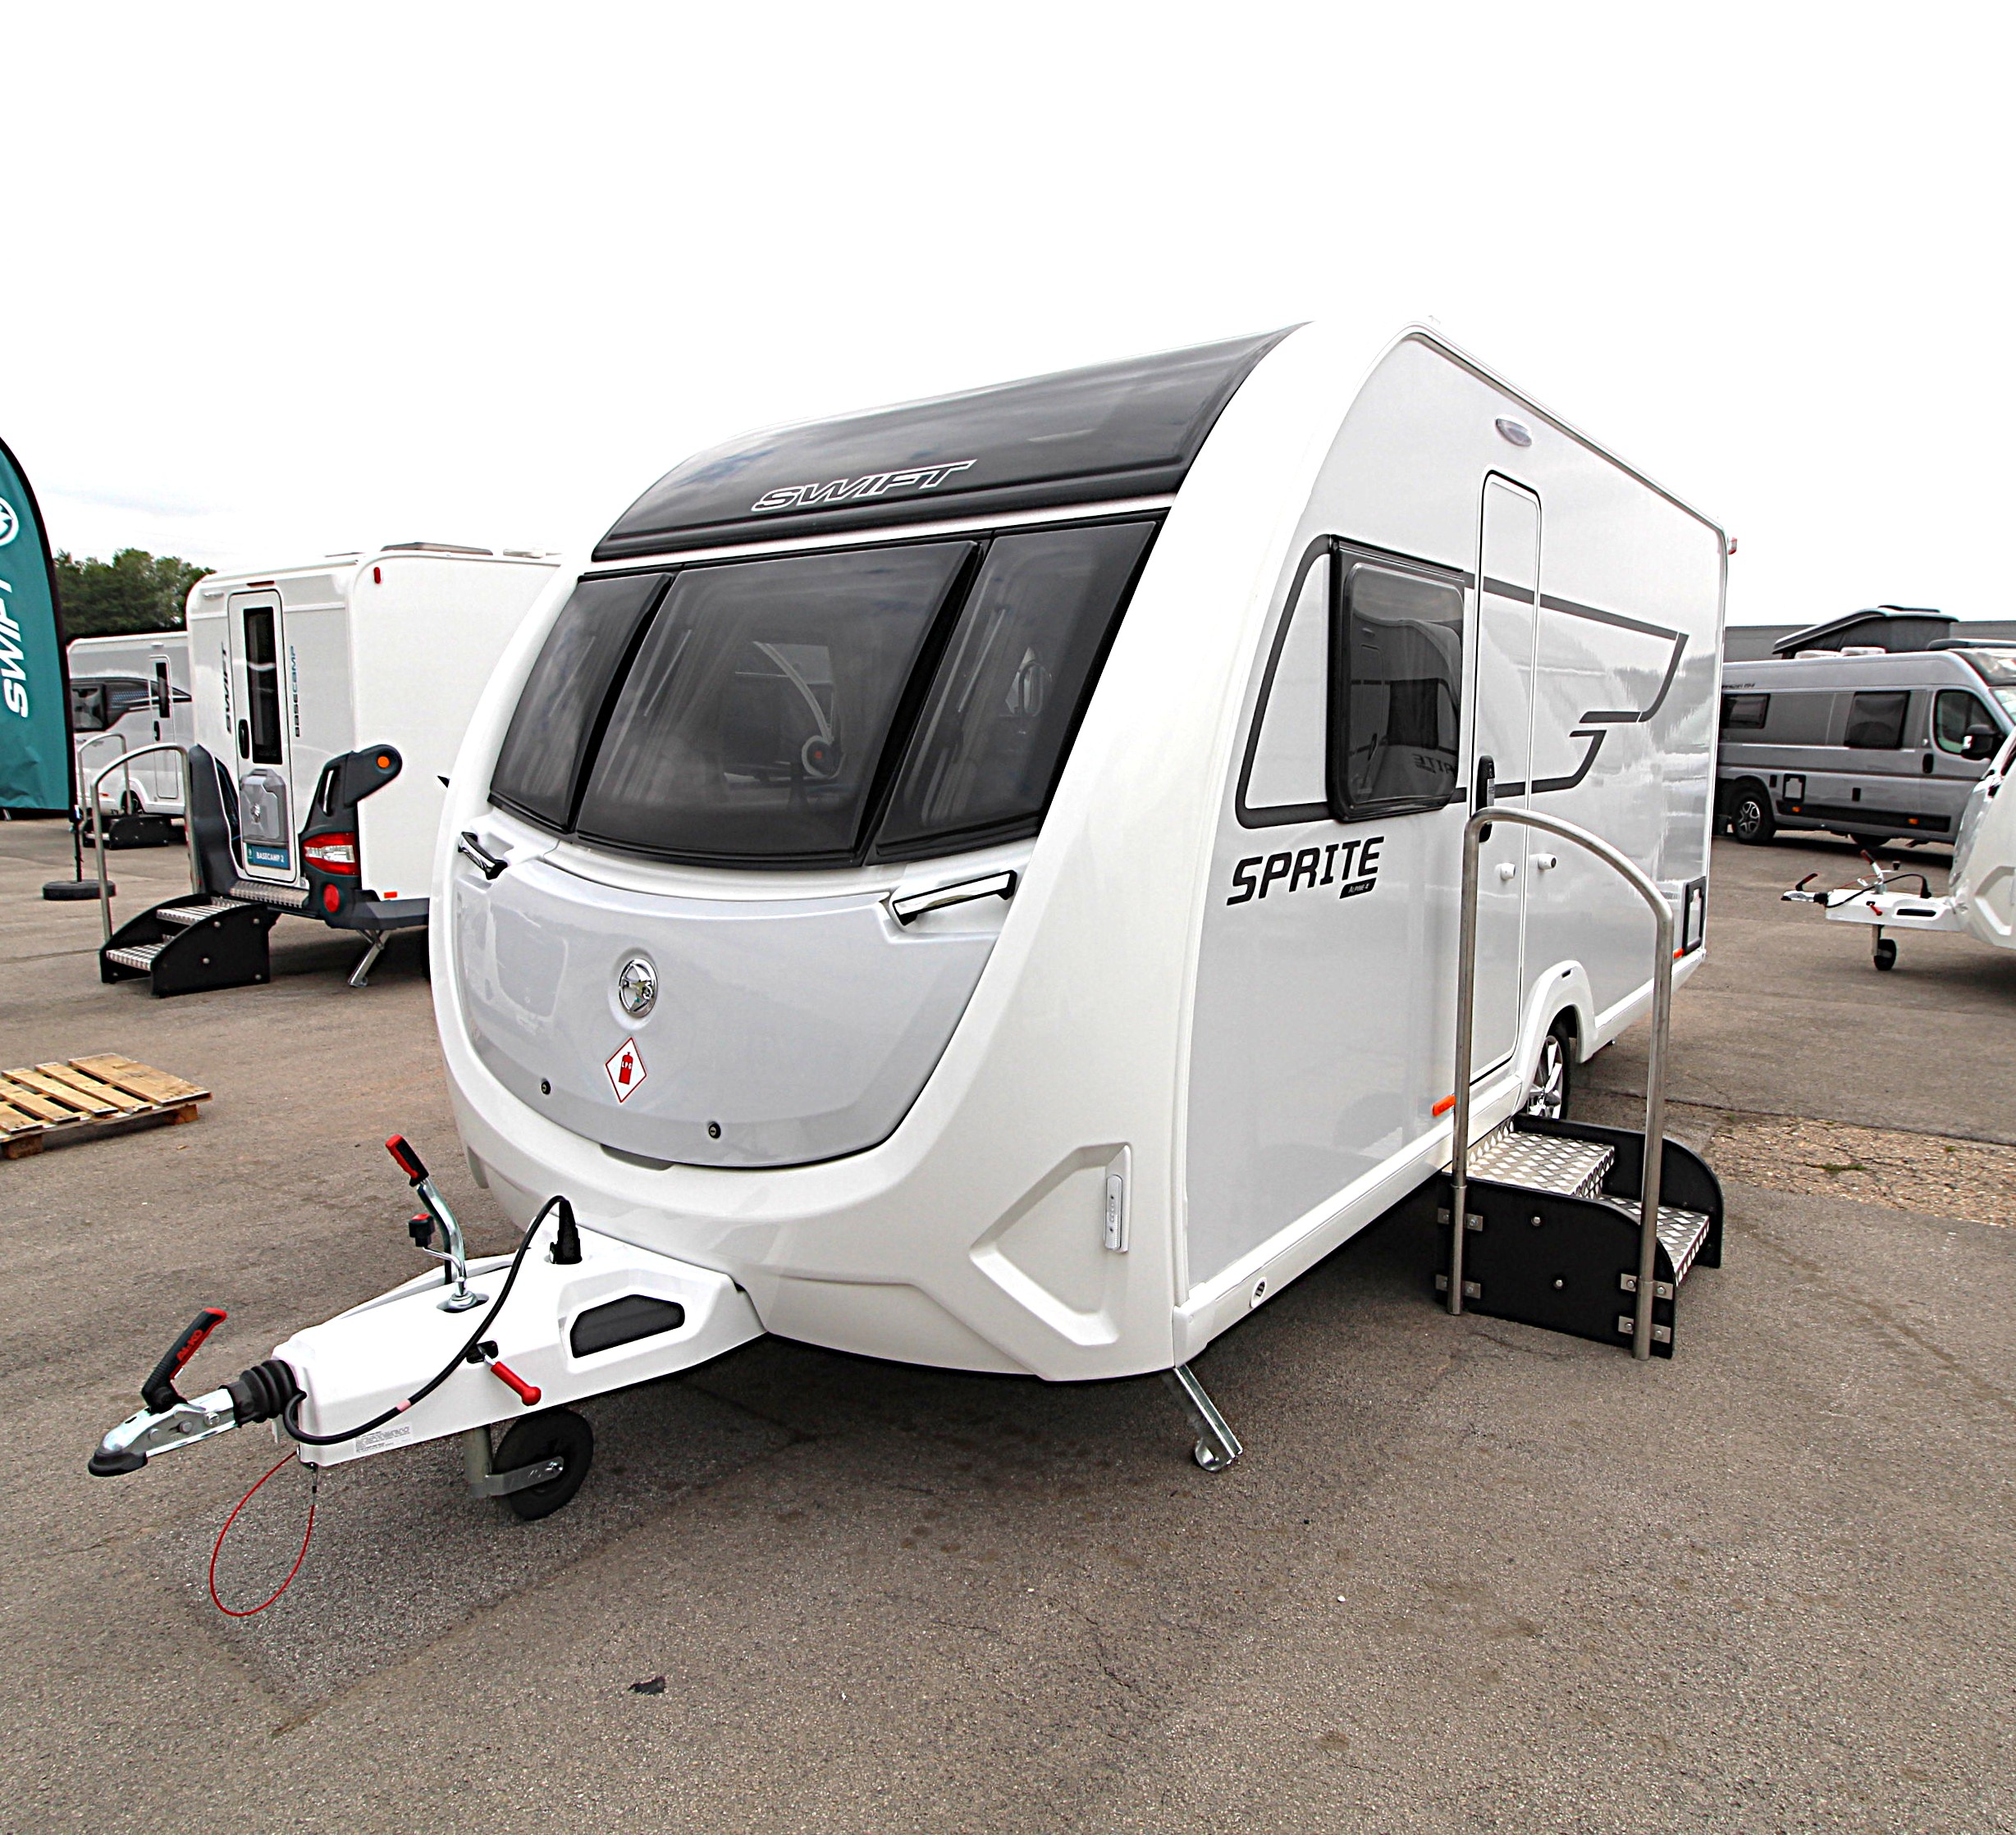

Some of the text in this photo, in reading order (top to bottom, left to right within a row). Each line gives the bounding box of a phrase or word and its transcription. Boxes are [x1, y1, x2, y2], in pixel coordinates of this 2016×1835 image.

[751, 459, 977, 512] SWIFT
[222, 641, 231, 733] SWIFT
[256, 851, 280, 862] BASECAMP
[1227, 836, 1384, 906] SPRITE
[622, 1061, 632, 1070] LPG
